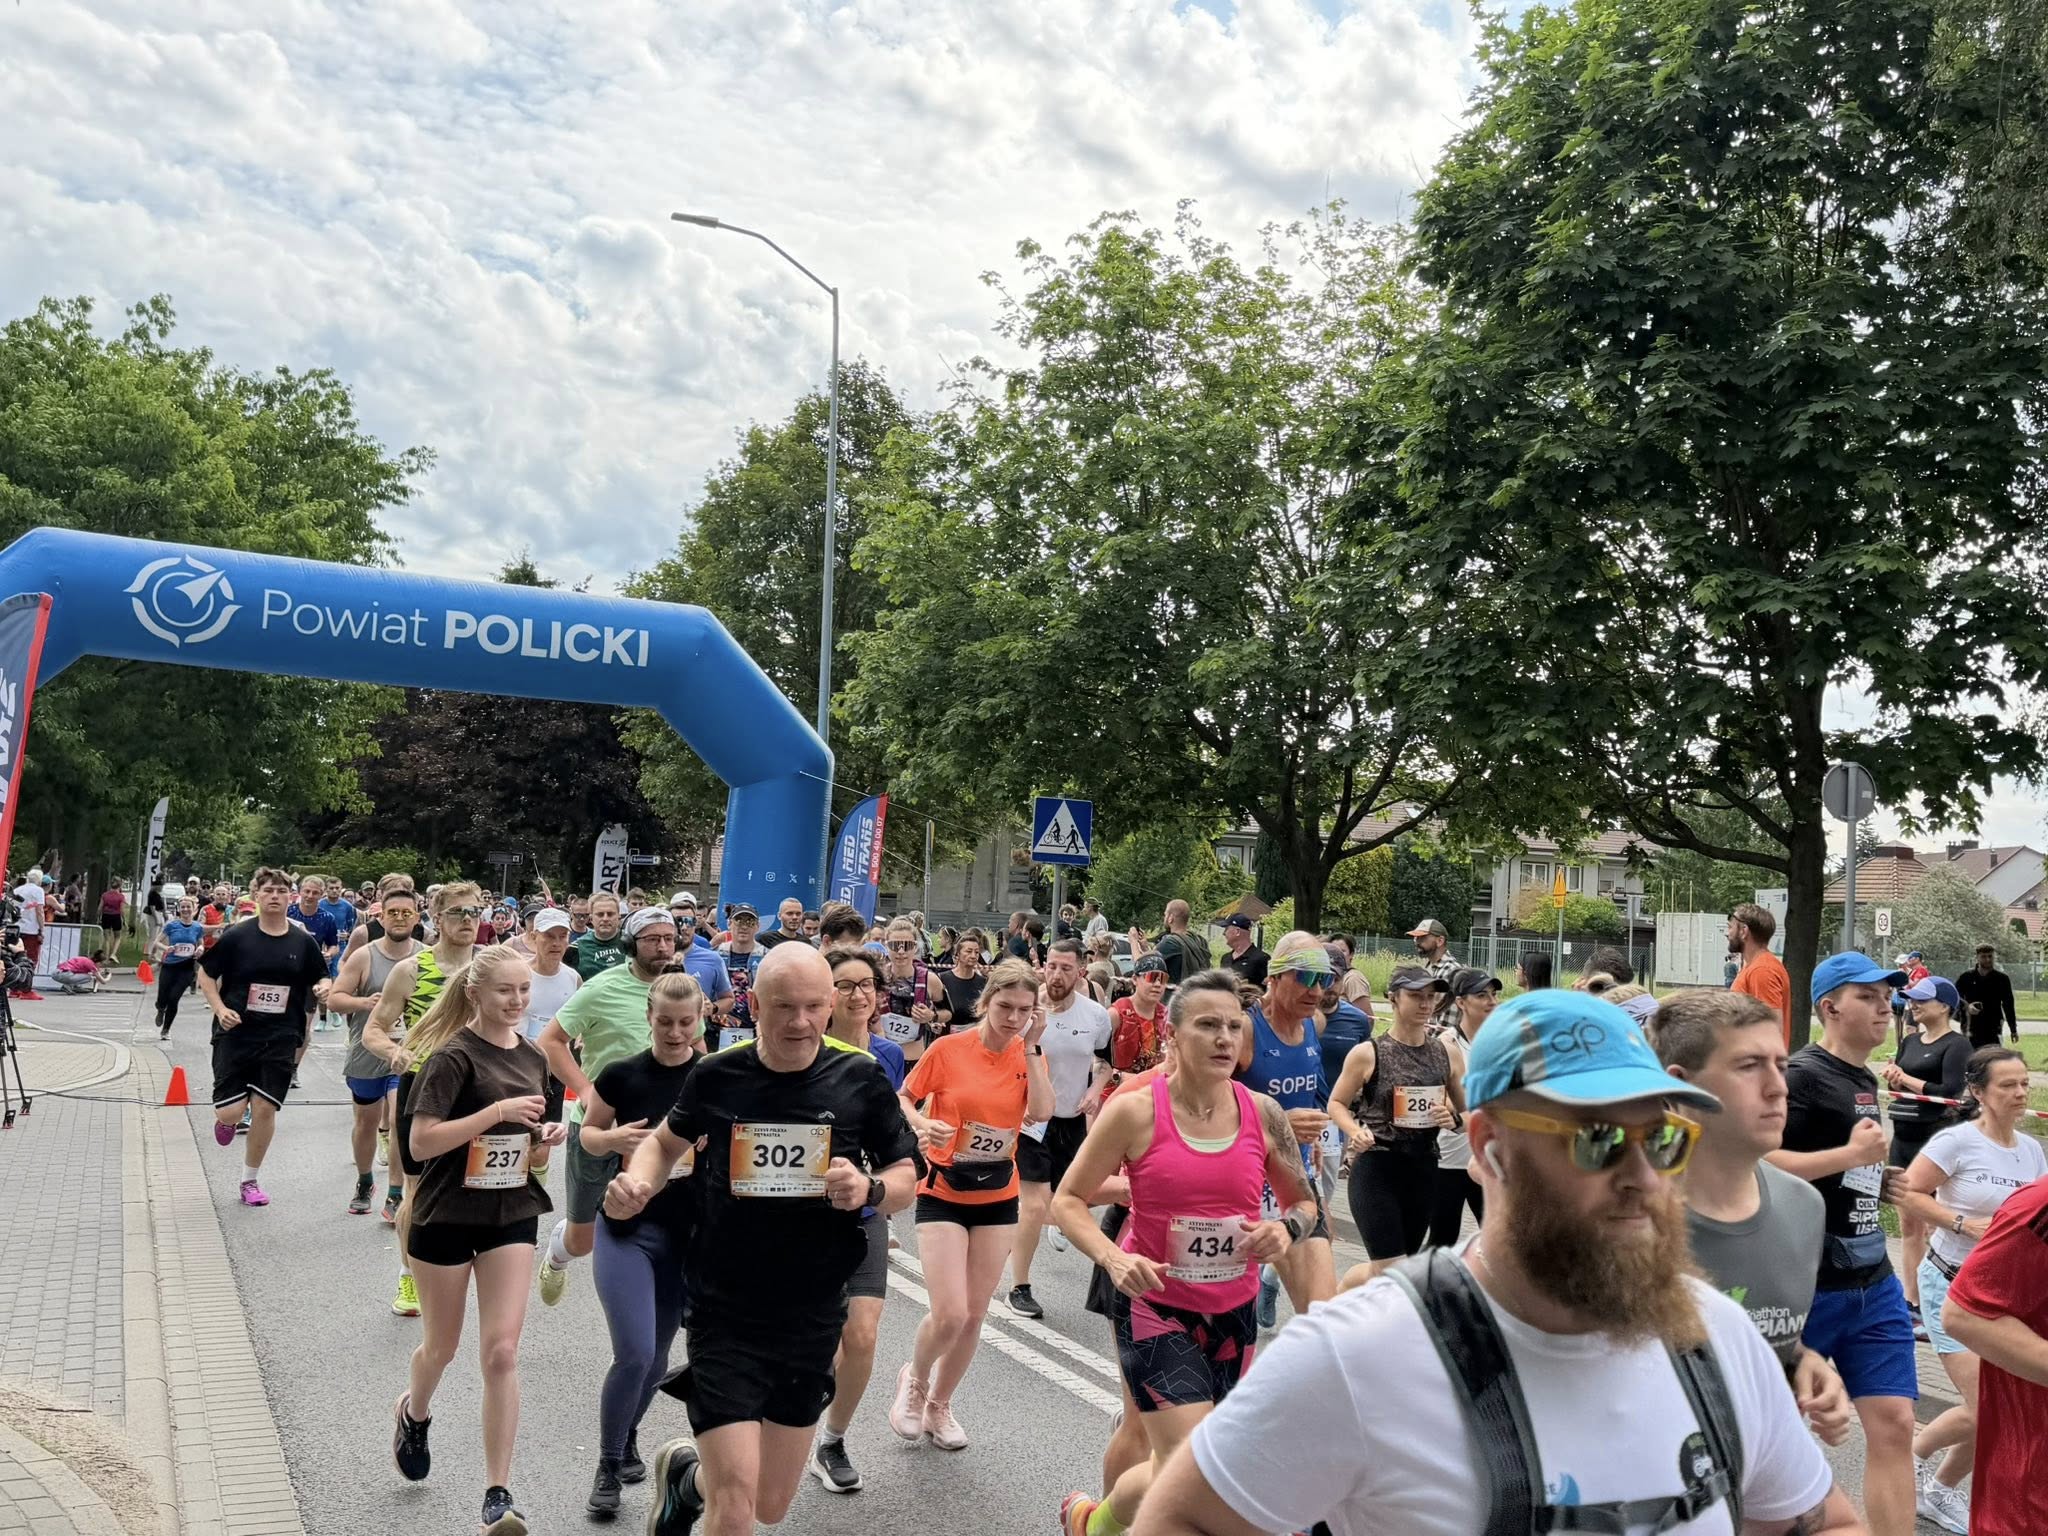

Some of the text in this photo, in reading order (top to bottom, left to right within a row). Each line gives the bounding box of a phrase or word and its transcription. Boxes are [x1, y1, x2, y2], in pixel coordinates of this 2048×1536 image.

[261, 589, 649, 667] Powiat POLICKI
[876, 816, 884, 827] 07
[874, 828, 882, 839] 00
[842, 834, 856, 873] MED
[858, 817, 873, 875] TRANS
[600, 852, 619, 894] ART
[258, 992, 280, 1003] 453
[888, 1021, 910, 1035] 122
[970, 1135, 1004, 1153] 229
[485, 1149, 521, 1168] 237
[752, 1144, 805, 1168] 302
[1187, 1235, 1235, 1258] 434
